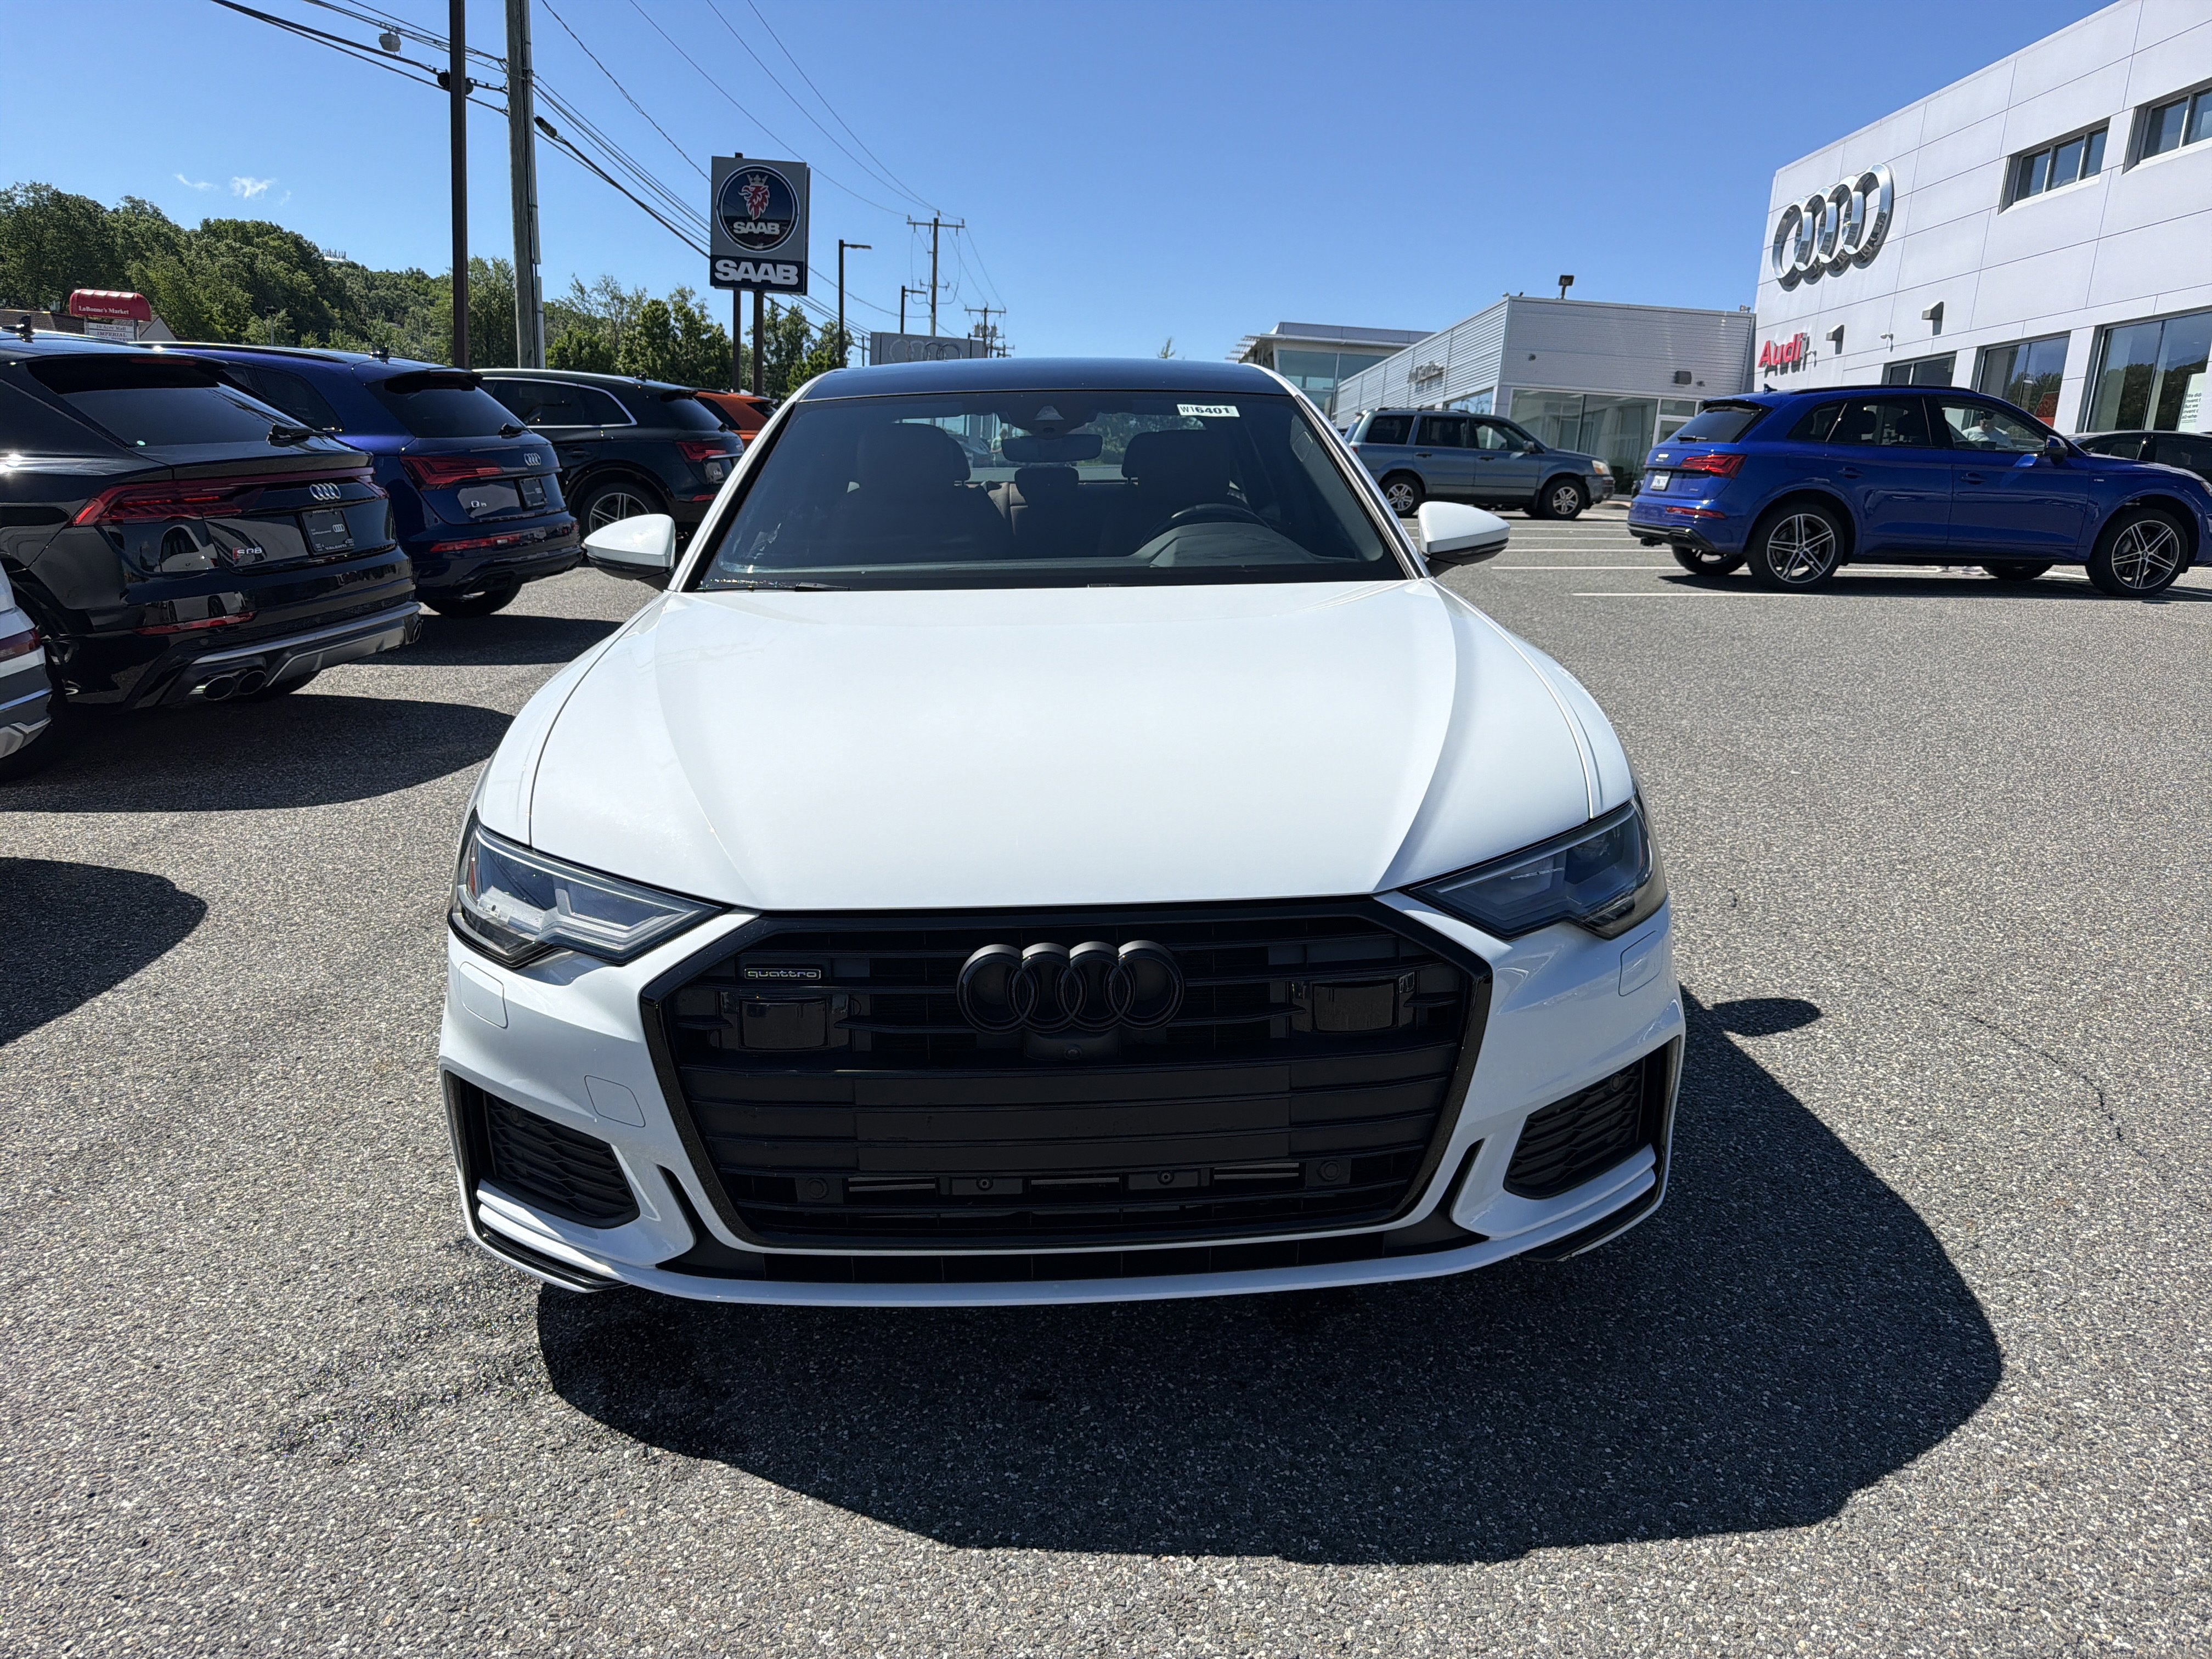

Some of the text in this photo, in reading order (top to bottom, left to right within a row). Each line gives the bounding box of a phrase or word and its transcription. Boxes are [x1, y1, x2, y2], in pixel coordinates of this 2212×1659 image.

[733, 222, 780, 235] SAAB
[714, 259, 799, 286] SAAB
[1758, 332, 1804, 368] Audi
[747, 969, 817, 979] quattro
